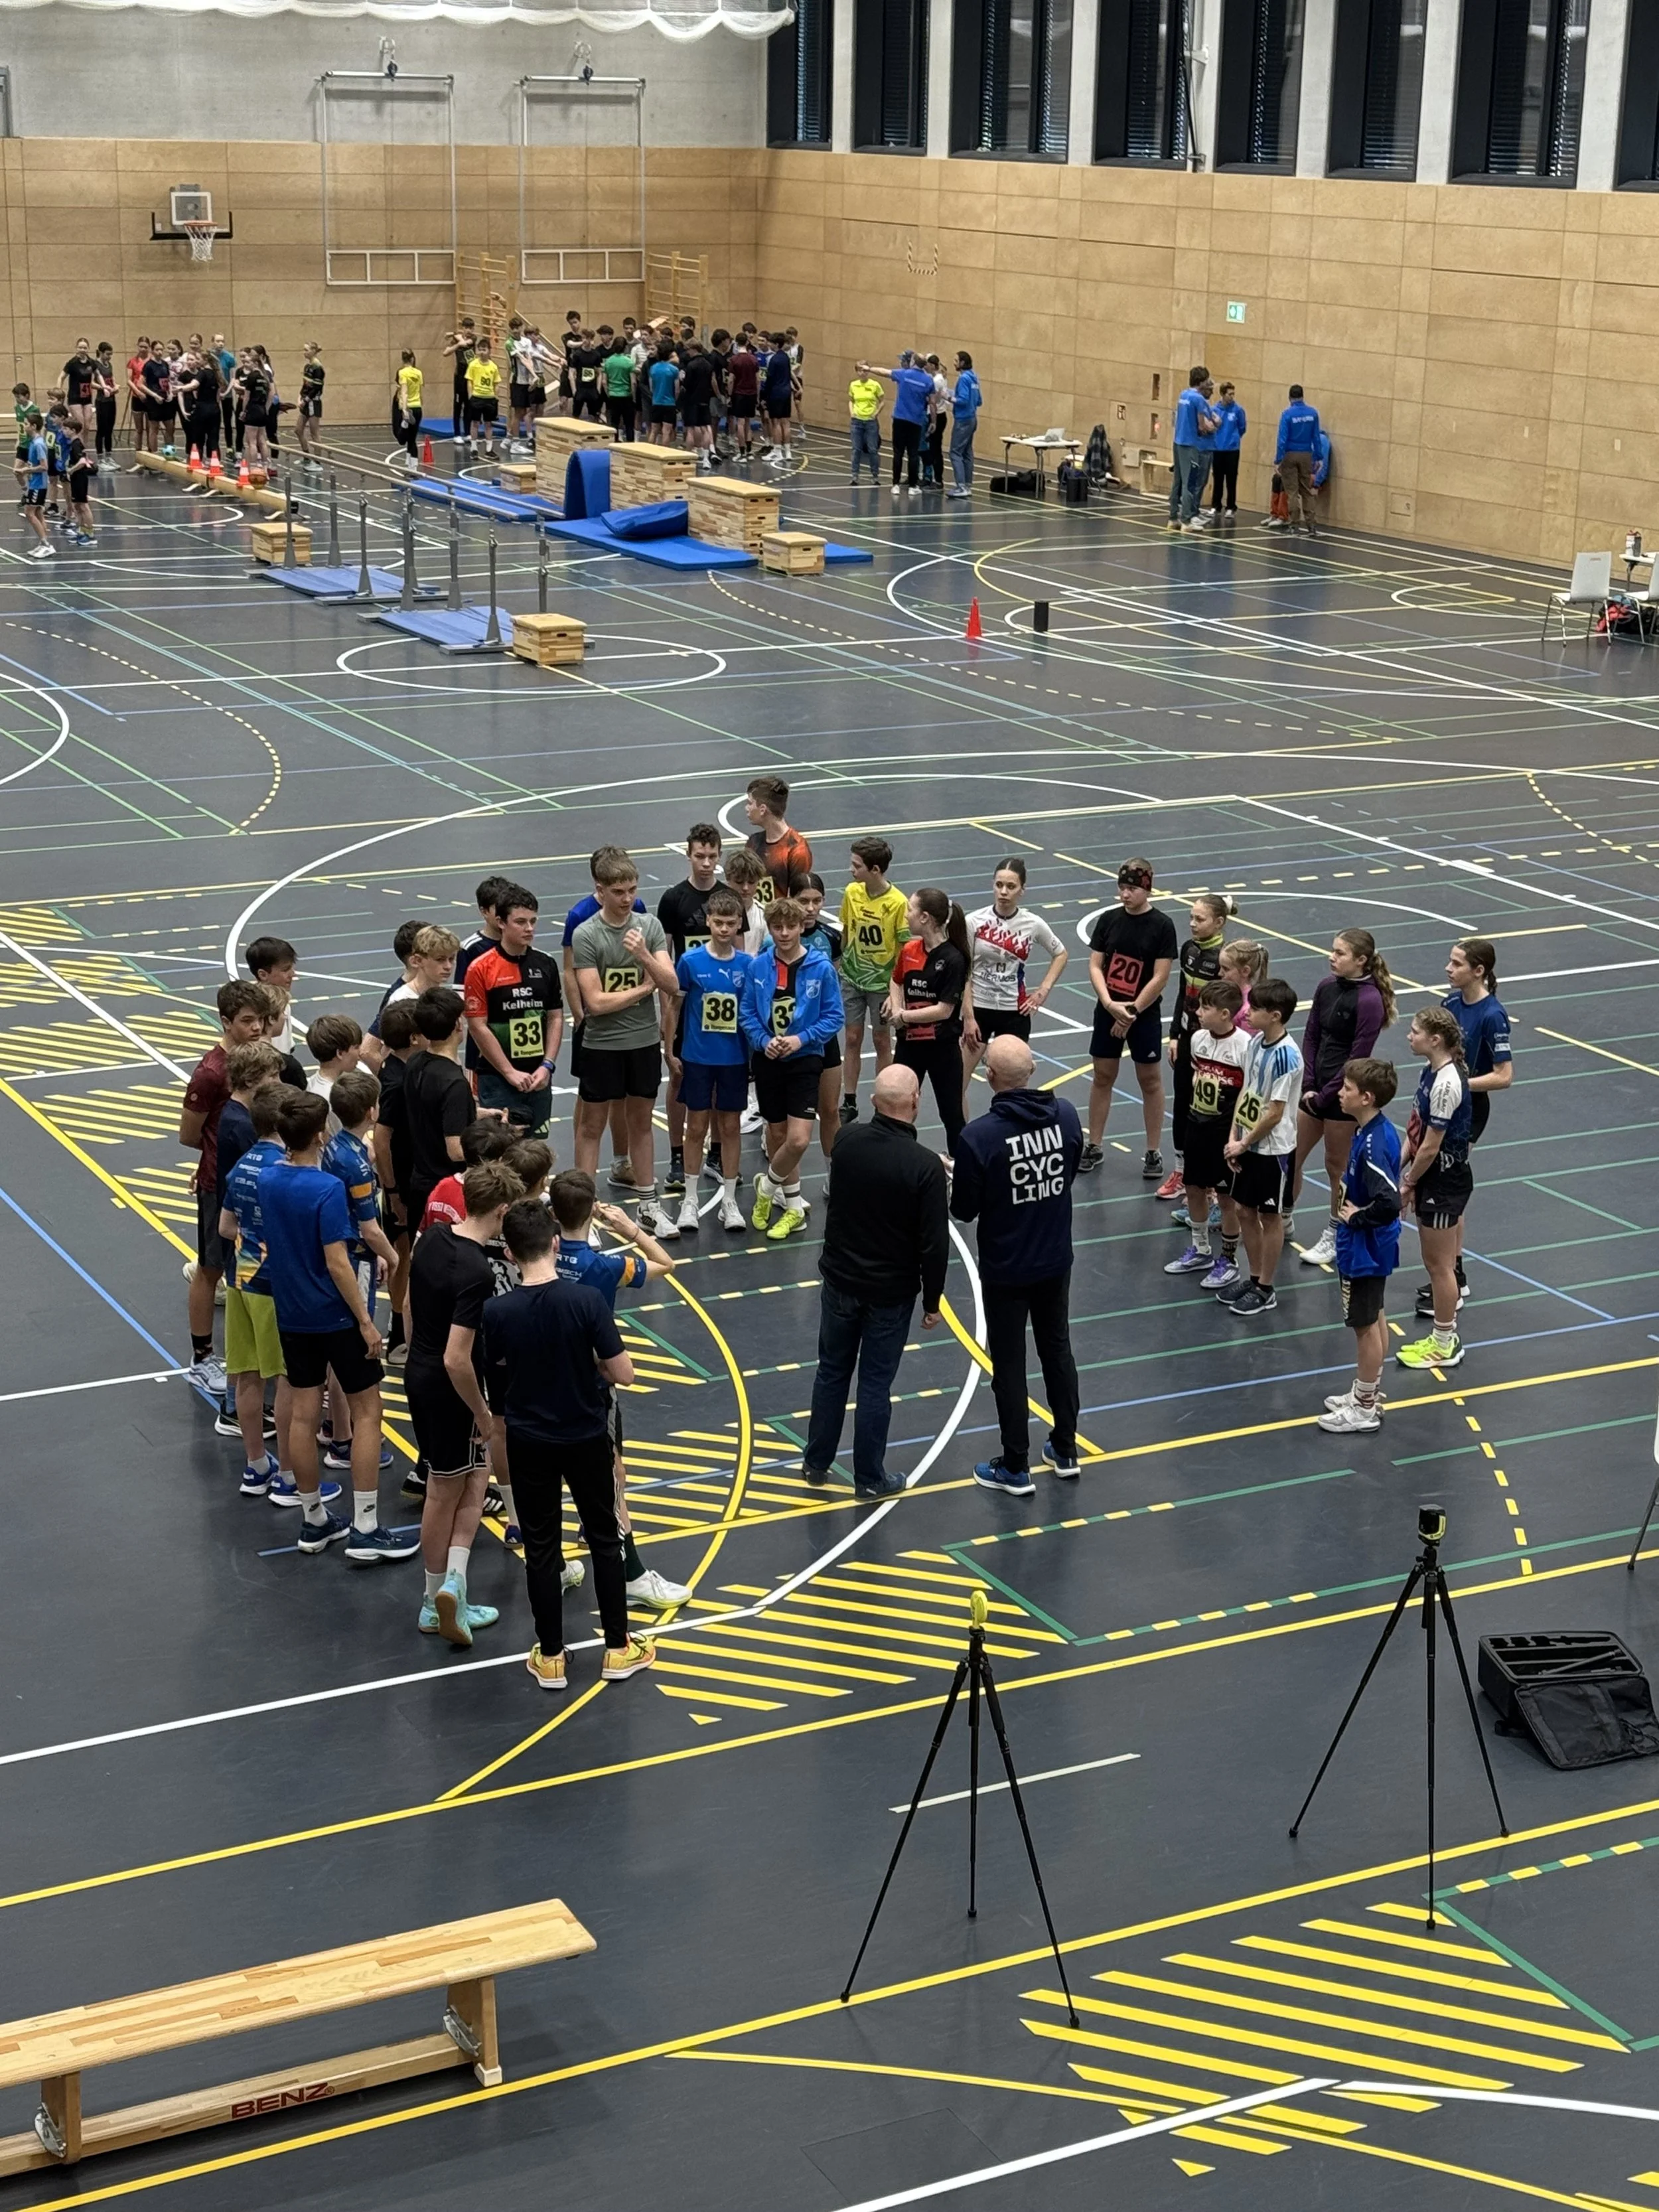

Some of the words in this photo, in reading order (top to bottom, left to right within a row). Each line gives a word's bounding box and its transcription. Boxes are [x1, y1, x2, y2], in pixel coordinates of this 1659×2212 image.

[859, 924, 882, 946] 40
[608, 972, 636, 992] 25
[912, 978, 927, 988] RSC
[1110, 958, 1139, 985] 20
[502, 999, 543, 1011] Kelheim
[512, 987, 533, 997] RSC
[705, 997, 735, 1022] 38
[514, 1021, 541, 1047] 33
[1195, 1080, 1216, 1106] 49
[1238, 1092, 1260, 1122] 26
[1005, 1124, 1063, 1162] INN
[1010, 1153, 1064, 1185] CYC
[1012, 1177, 1064, 1205] LING
